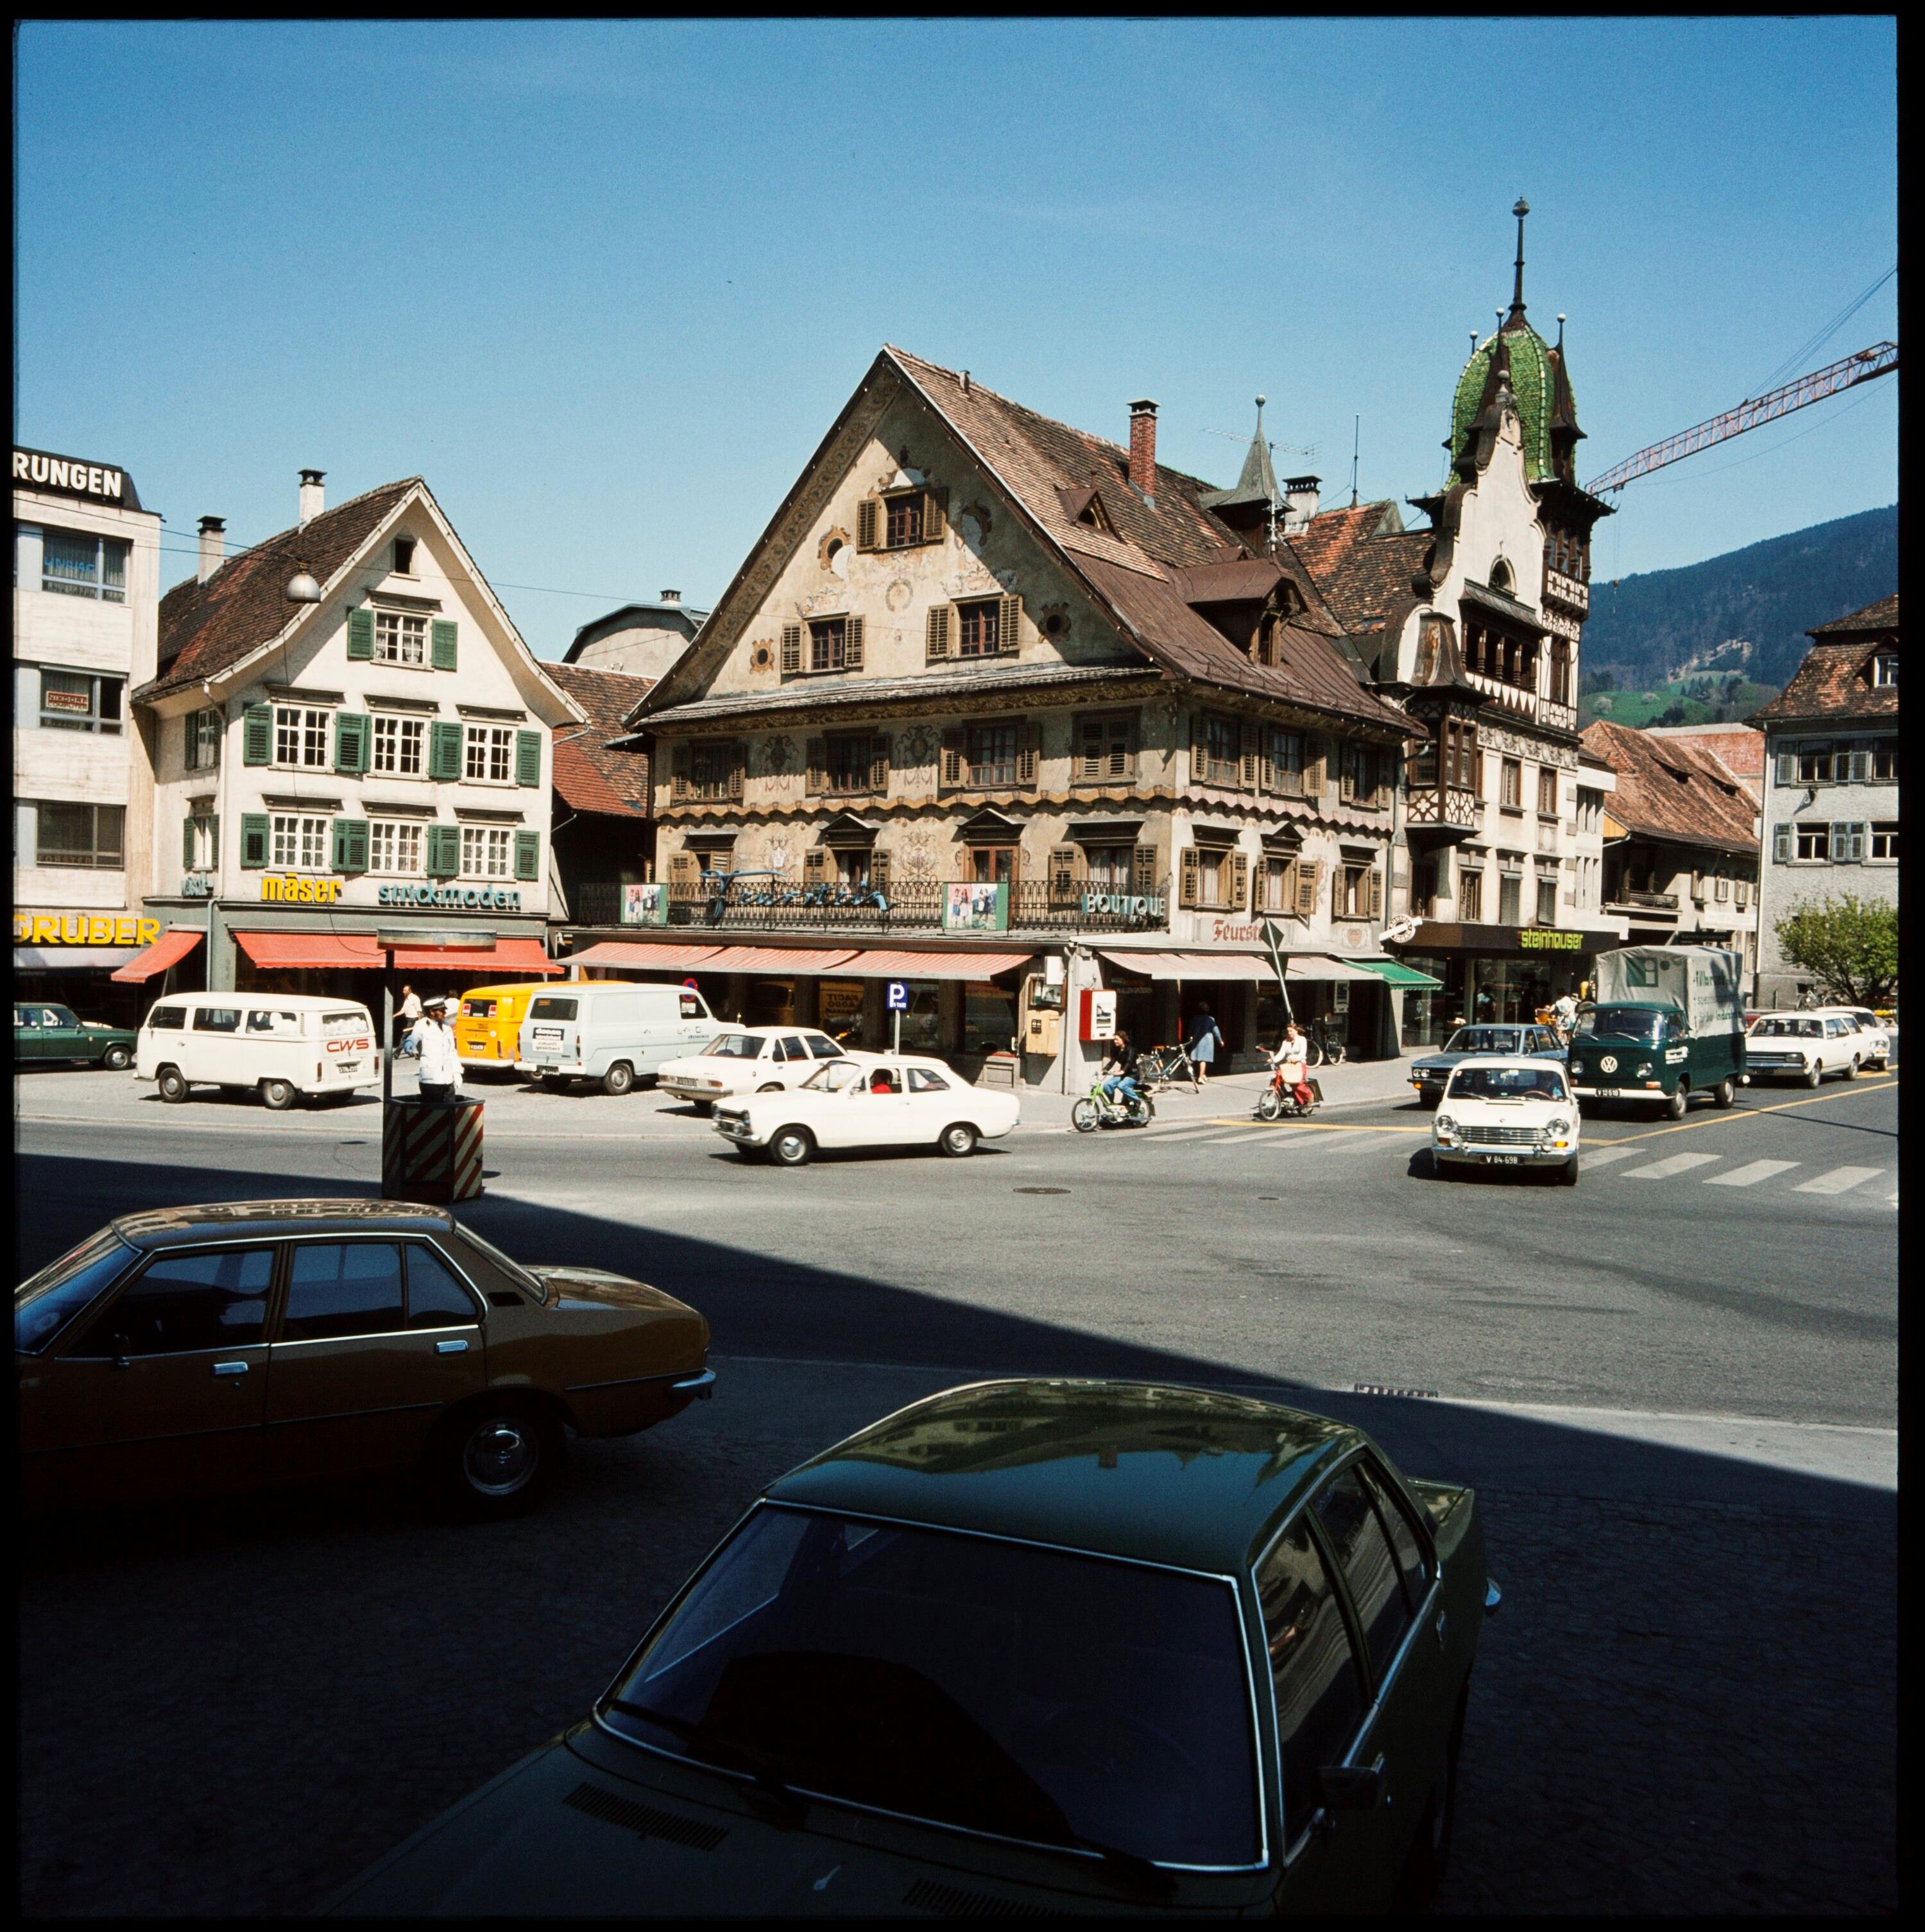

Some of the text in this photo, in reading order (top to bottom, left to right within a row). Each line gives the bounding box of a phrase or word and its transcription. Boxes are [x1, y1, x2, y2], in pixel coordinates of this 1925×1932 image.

[13, 451, 121, 498] RUNGEN
[379, 879, 522, 908] strickmoden
[1082, 893, 1166, 918] BOUTIQUE
[1521, 928, 1584, 950] steinhauser
[889, 983, 905, 1008] P
[326, 1038, 369, 1053] CWS
